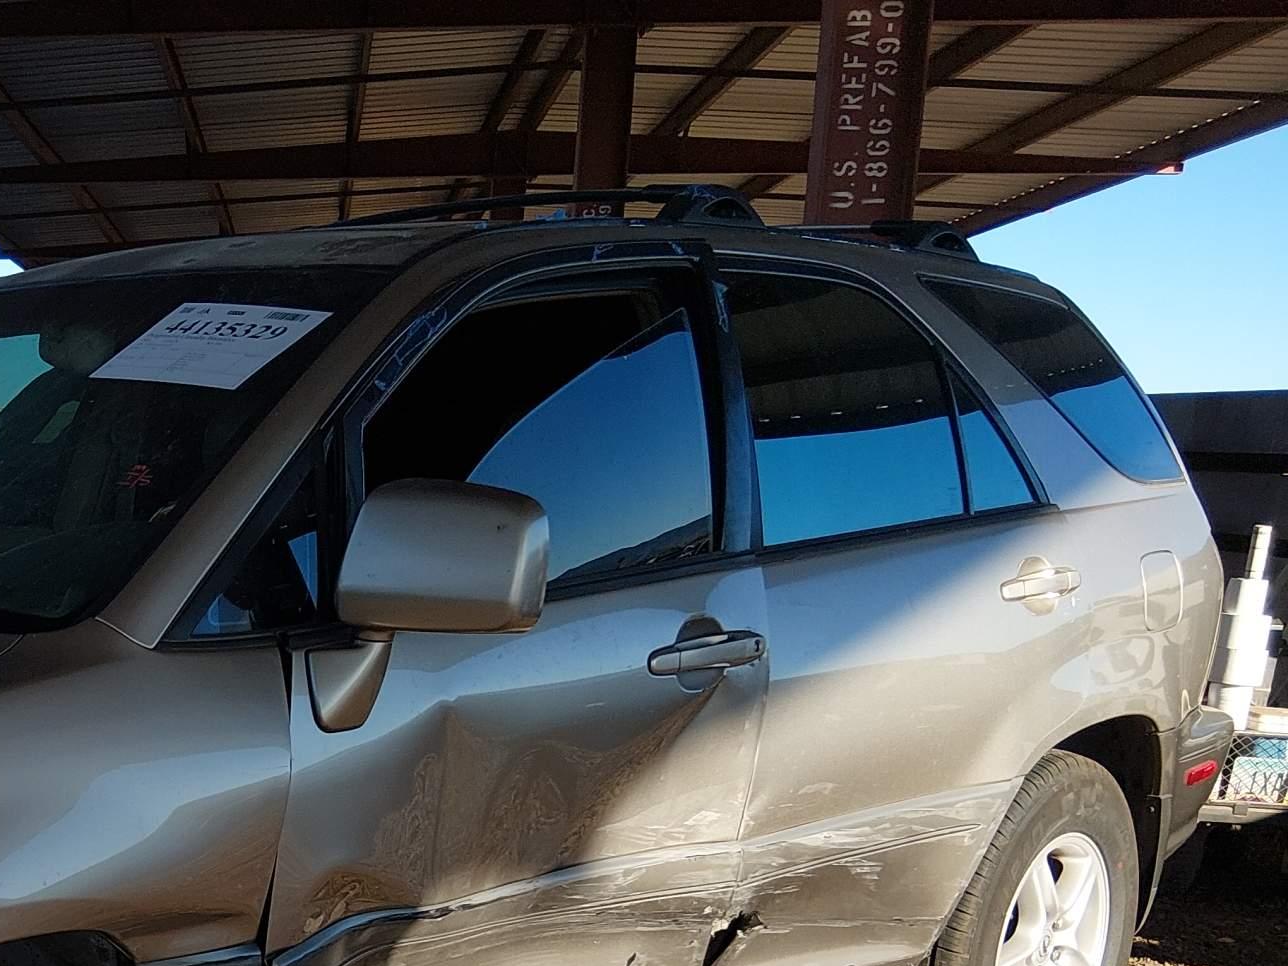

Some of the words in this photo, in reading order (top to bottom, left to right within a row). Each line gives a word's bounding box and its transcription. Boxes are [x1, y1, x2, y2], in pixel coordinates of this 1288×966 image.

[837, 9, 872, 131] PREFAB
[861, 0, 904, 204] 1-866-799-0
[828, 151, 859, 209] U.S.
[164, 319, 289, 341] 44135329
